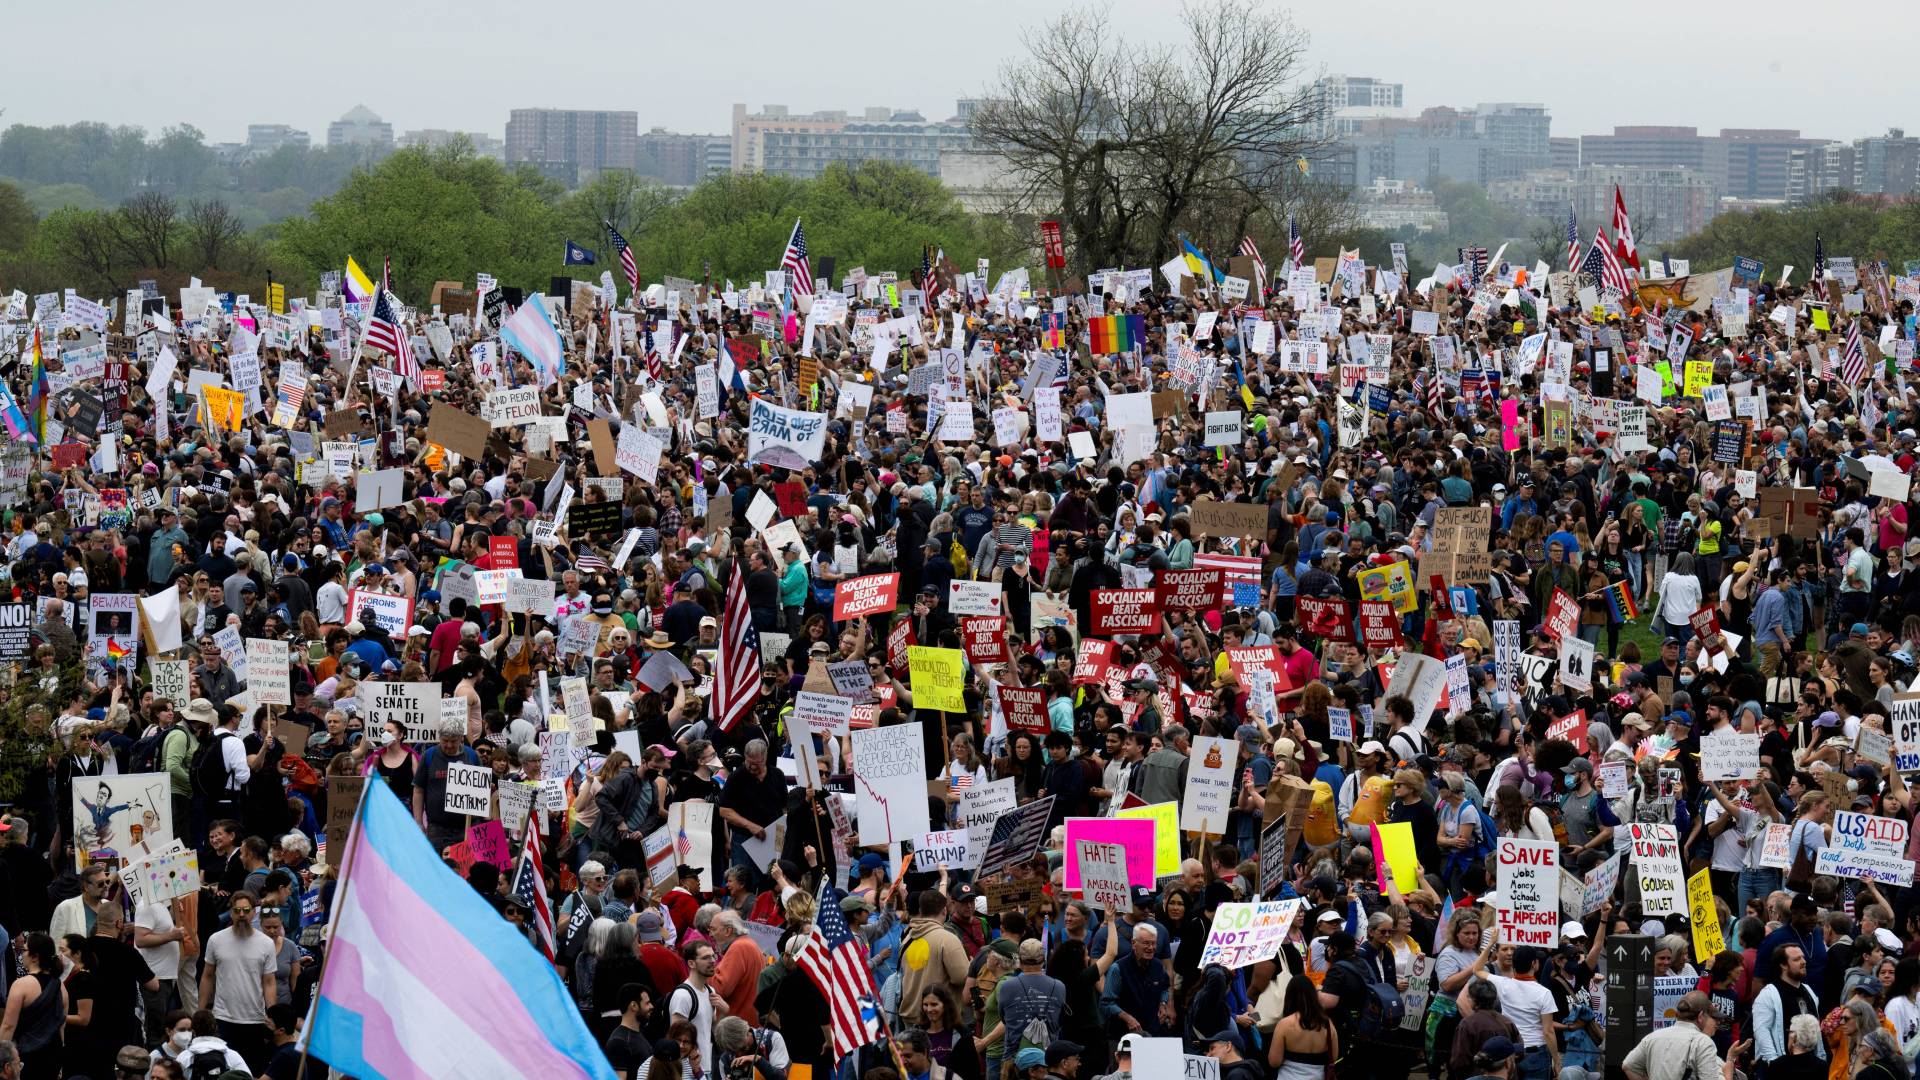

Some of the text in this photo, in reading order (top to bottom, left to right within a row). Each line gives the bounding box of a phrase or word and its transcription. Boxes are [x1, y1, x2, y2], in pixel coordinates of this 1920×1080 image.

[1284, 340, 1322, 349] American
[110, 363, 122, 380] NO
[1342, 366, 1368, 388] SHAME
[510, 391, 536, 404] REIGN
[505, 403, 541, 420] FELON
[1207, 423, 1240, 435] FIGHT BACK
[326, 442, 346, 451] HANDS
[617, 449, 657, 479] DOMESTIC
[1439, 509, 1488, 525] SAVE USA
[1464, 527, 1490, 541] TRUMP
[1457, 555, 1481, 564] TRUMP
[482, 572, 518, 581] UPHOLD
[1163, 571, 1220, 586] SOCIALISM
[1456, 570, 1490, 581] CONMAN
[512, 584, 551, 598] HANDS
[840, 575, 893, 595] SOCIALISM
[1177, 583, 1206, 596] BEATS
[854, 587, 880, 602] BEATS
[1098, 591, 1155, 605] SOCIALISM
[1165, 593, 1216, 607] FASCISM!
[92, 596, 137, 610] BEWARE
[356, 597, 397, 609] MORONS
[841, 594, 888, 615] FASCISM!
[1112, 603, 1142, 616] BEATS
[1555, 591, 1580, 621] SOCIALISM
[1611, 586, 1632, 619] RESIST
[0, 605, 31, 627] NO!
[1362, 603, 1391, 617] SOCIALISM
[966, 618, 1002, 636] SOCIALISM
[1101, 614, 1153, 628] FASCISM!
[1368, 616, 1384, 628] BEATS
[1494, 622, 1506, 634] NO
[975, 632, 993, 645] BEATS
[1365, 627, 1395, 641] FASCISM!
[1494, 636, 1506, 648] NO
[971, 643, 1001, 657] FASCISM!
[1230, 648, 1276, 663] SOCIALISM
[155, 661, 182, 673] TAX
[830, 666, 867, 679] TAKE BACK
[1445, 661, 1457, 671] Keep
[155, 674, 184, 686] RICH
[839, 677, 867, 690] THE
[156, 684, 185, 696] STOP
[384, 684, 406, 696] THE
[1002, 688, 1043, 705] SOCIALISM
[376, 696, 420, 710] SENATE
[801, 694, 811, 702] You
[811, 696, 826, 704] teach
[836, 698, 849, 707] boys
[1013, 702, 1034, 715] BEATS
[368, 711, 425, 726] IS A DEI
[801, 713, 846, 724] will teach them
[1009, 711, 1045, 727] FASCISM!
[853, 731, 879, 745] JUST
[862, 738, 910, 755] ANOTHER
[856, 747, 920, 767] REPUBLICAN
[858, 761, 919, 780] RECESSION
[449, 768, 492, 790] FUCK ELON
[1191, 777, 1230, 788] ORANGE TURDS
[823, 783, 845, 791] WILL
[445, 793, 488, 812] FUCK TRUMP
[964, 791, 981, 801] KEEP
[965, 811, 1000, 828] HANDS
[475, 827, 491, 840] MY
[1631, 823, 1656, 840] OUR
[1837, 812, 1906, 843] USAID
[926, 831, 955, 848] FIRE
[1833, 834, 1841, 843] is
[1842, 835, 1867, 852] both
[915, 846, 966, 868] TRUMP
[1084, 844, 1117, 864] HATE
[1499, 842, 1555, 867] SAVE
[1634, 842, 1677, 859] ECONOMY
[1820, 850, 1845, 863] and
[1512, 867, 1535, 879] Jobs
[1641, 864, 1679, 874] IS IN YOUR
[1835, 865, 1855, 877] NOT
[1855, 867, 1898, 885] ZERO-SUM
[1087, 878, 1127, 893] AMERICA
[1510, 880, 1536, 894] Money
[1641, 876, 1674, 892] GOLDEN
[1094, 891, 1127, 907] GREAT
[1510, 890, 1541, 902] Schools
[1693, 890, 1703, 904] HAS
[1513, 901, 1536, 912] Lives
[1645, 897, 1673, 912] TOILET
[1215, 902, 1291, 931] SO MUCH
[1498, 910, 1557, 926] IMPEACH
[1502, 924, 1552, 945] TRUMP
[1705, 920, 1719, 937] EYES
[1210, 931, 1250, 945] NOT
[1703, 937, 1724, 952] ON US
[1405, 974, 1430, 993] TRUMP
